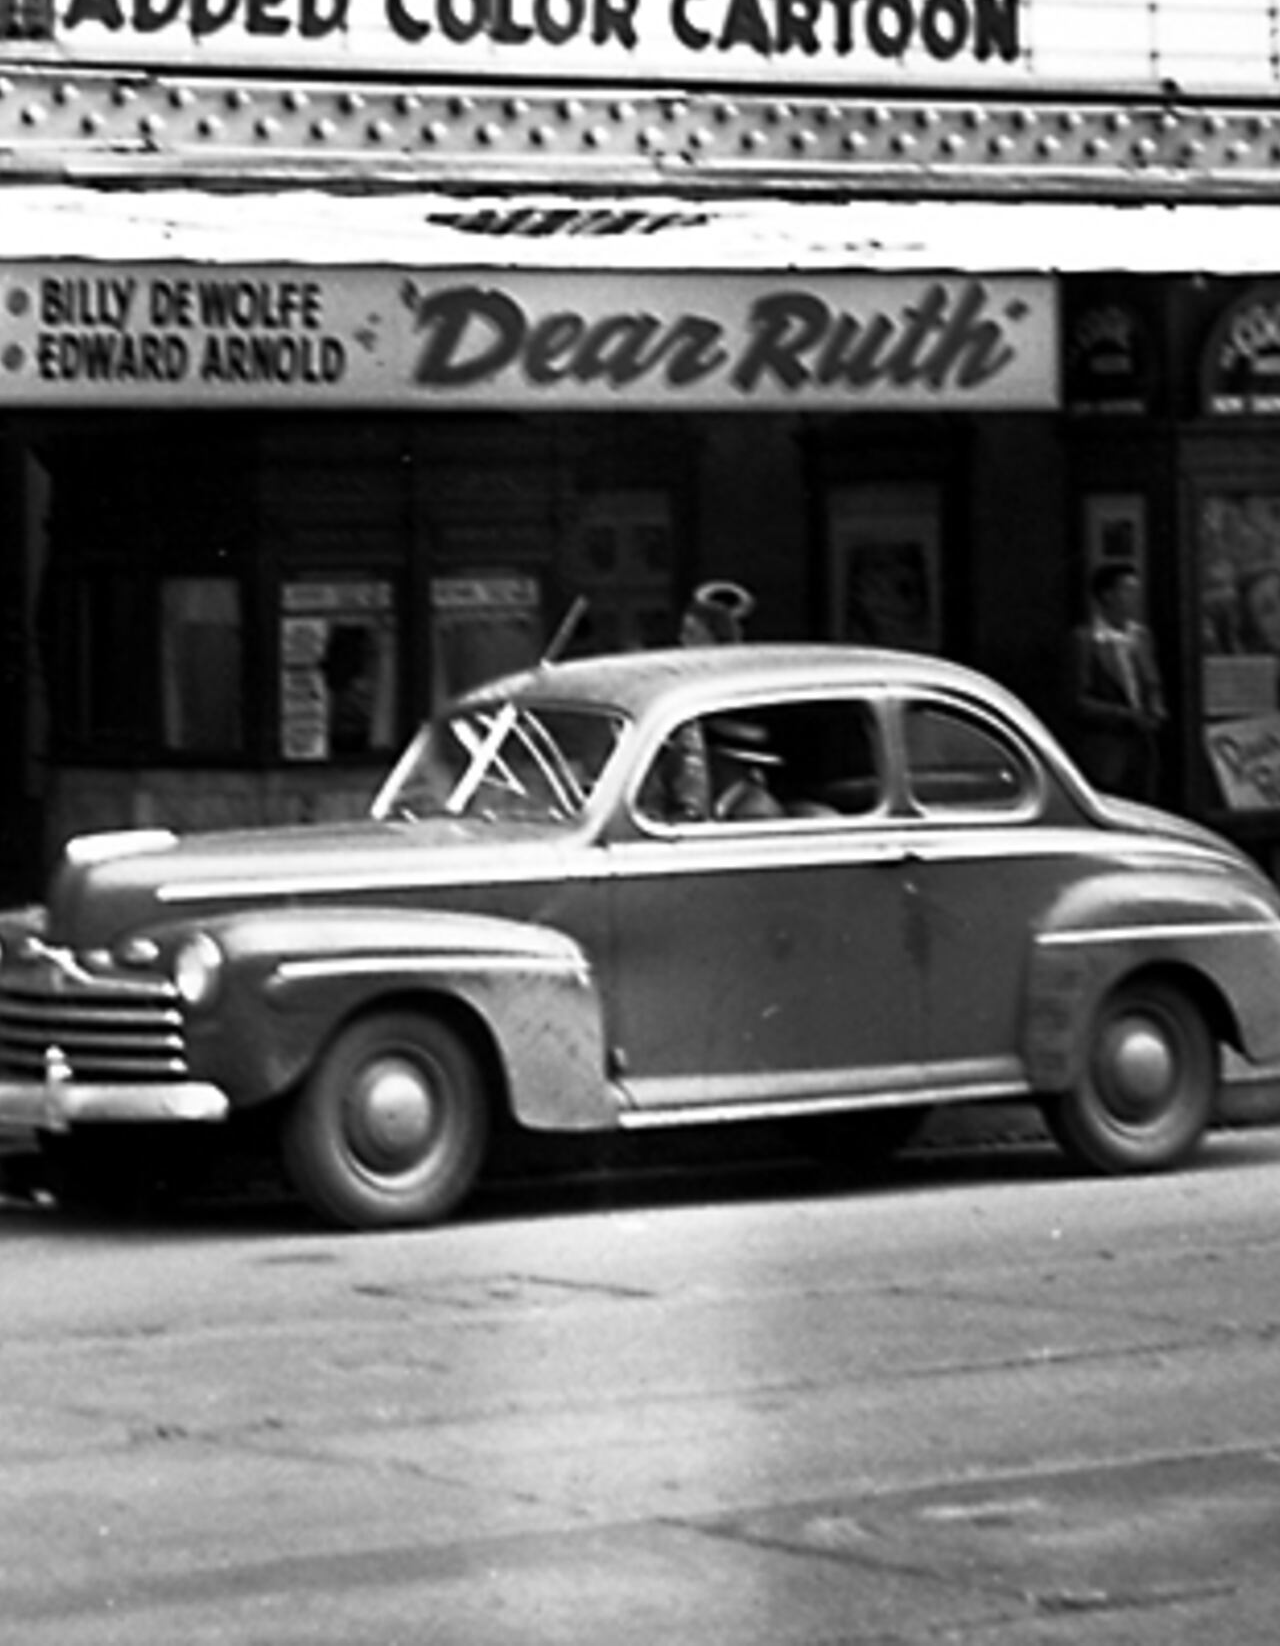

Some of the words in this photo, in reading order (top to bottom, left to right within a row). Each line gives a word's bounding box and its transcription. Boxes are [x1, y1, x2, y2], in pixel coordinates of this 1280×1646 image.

[40, 276, 137, 331] BILLY
[37, 332, 191, 382] EDWARD
[200, 335, 347, 384] ARNOLD
